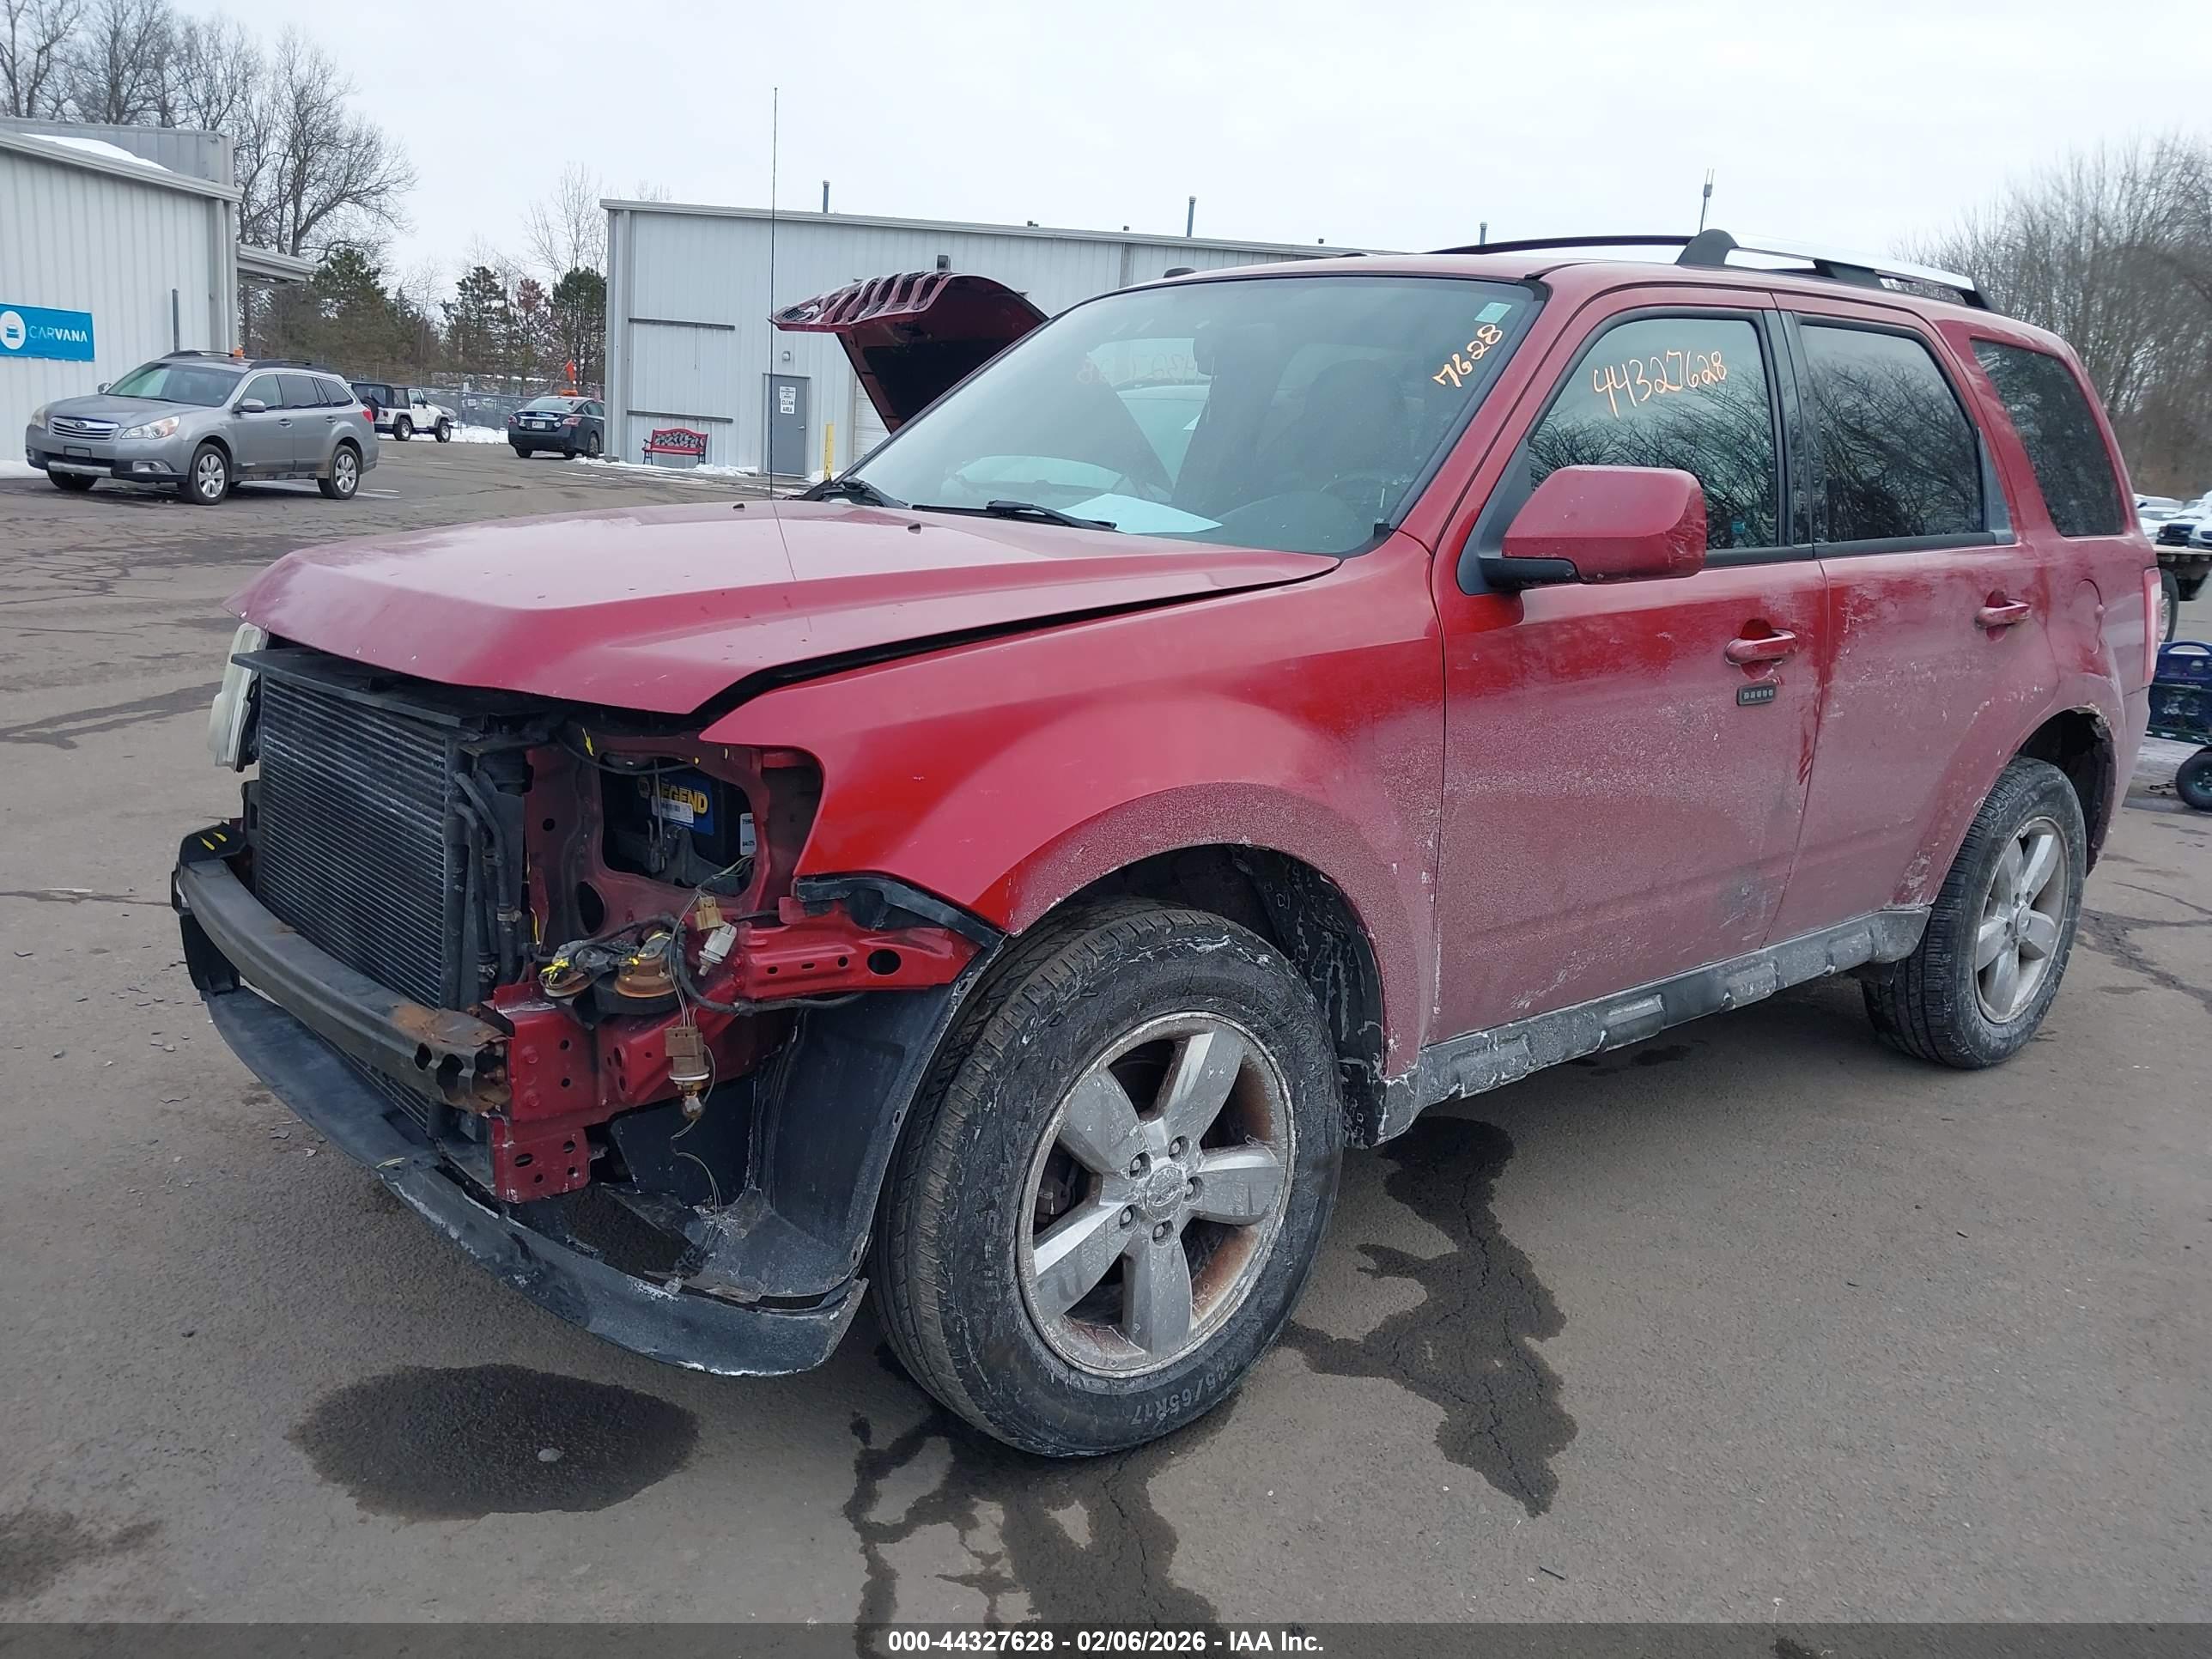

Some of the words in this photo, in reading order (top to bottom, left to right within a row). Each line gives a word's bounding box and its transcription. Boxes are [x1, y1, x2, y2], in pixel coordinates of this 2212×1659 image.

[28, 325, 88, 343] CARVANA
[1431, 325, 1503, 387] 7628
[1593, 350, 1728, 419] 44327628
